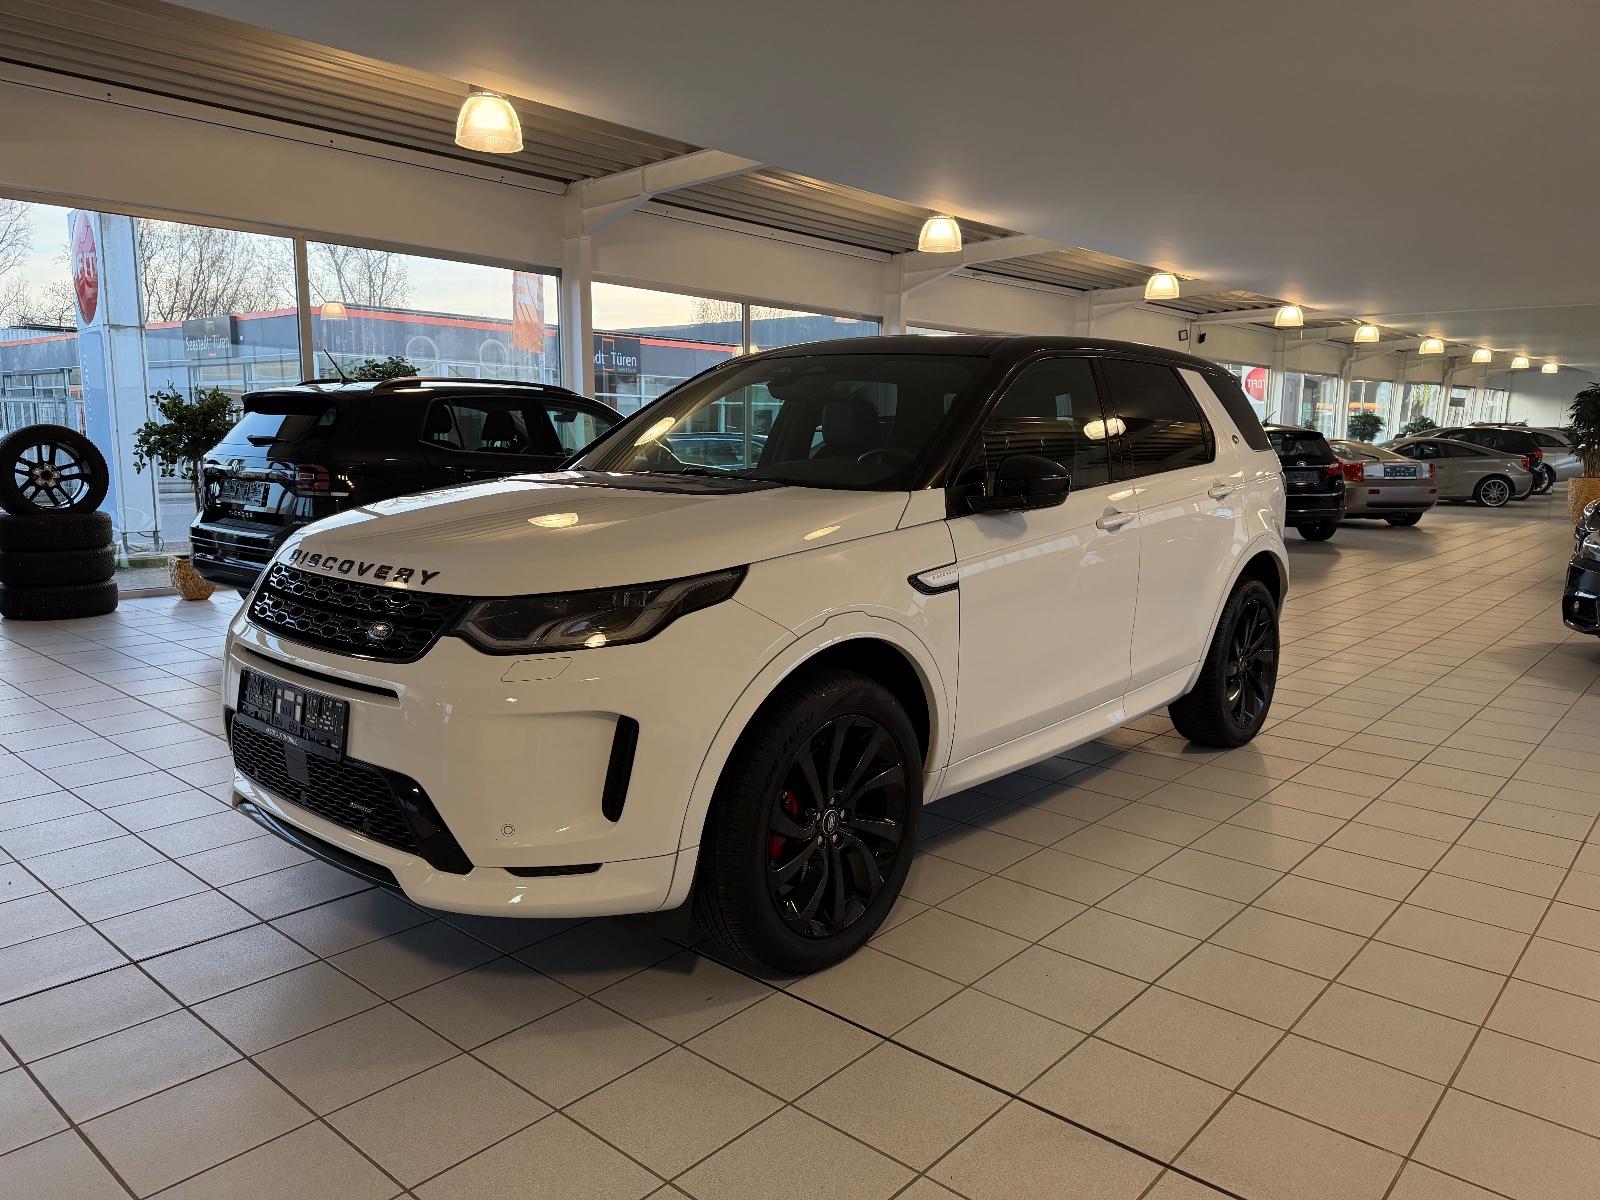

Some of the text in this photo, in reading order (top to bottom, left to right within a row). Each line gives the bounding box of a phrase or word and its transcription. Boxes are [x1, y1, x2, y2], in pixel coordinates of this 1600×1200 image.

[593, 350, 637, 367] dt Türen
[289, 548, 440, 586] DISCOVERY
